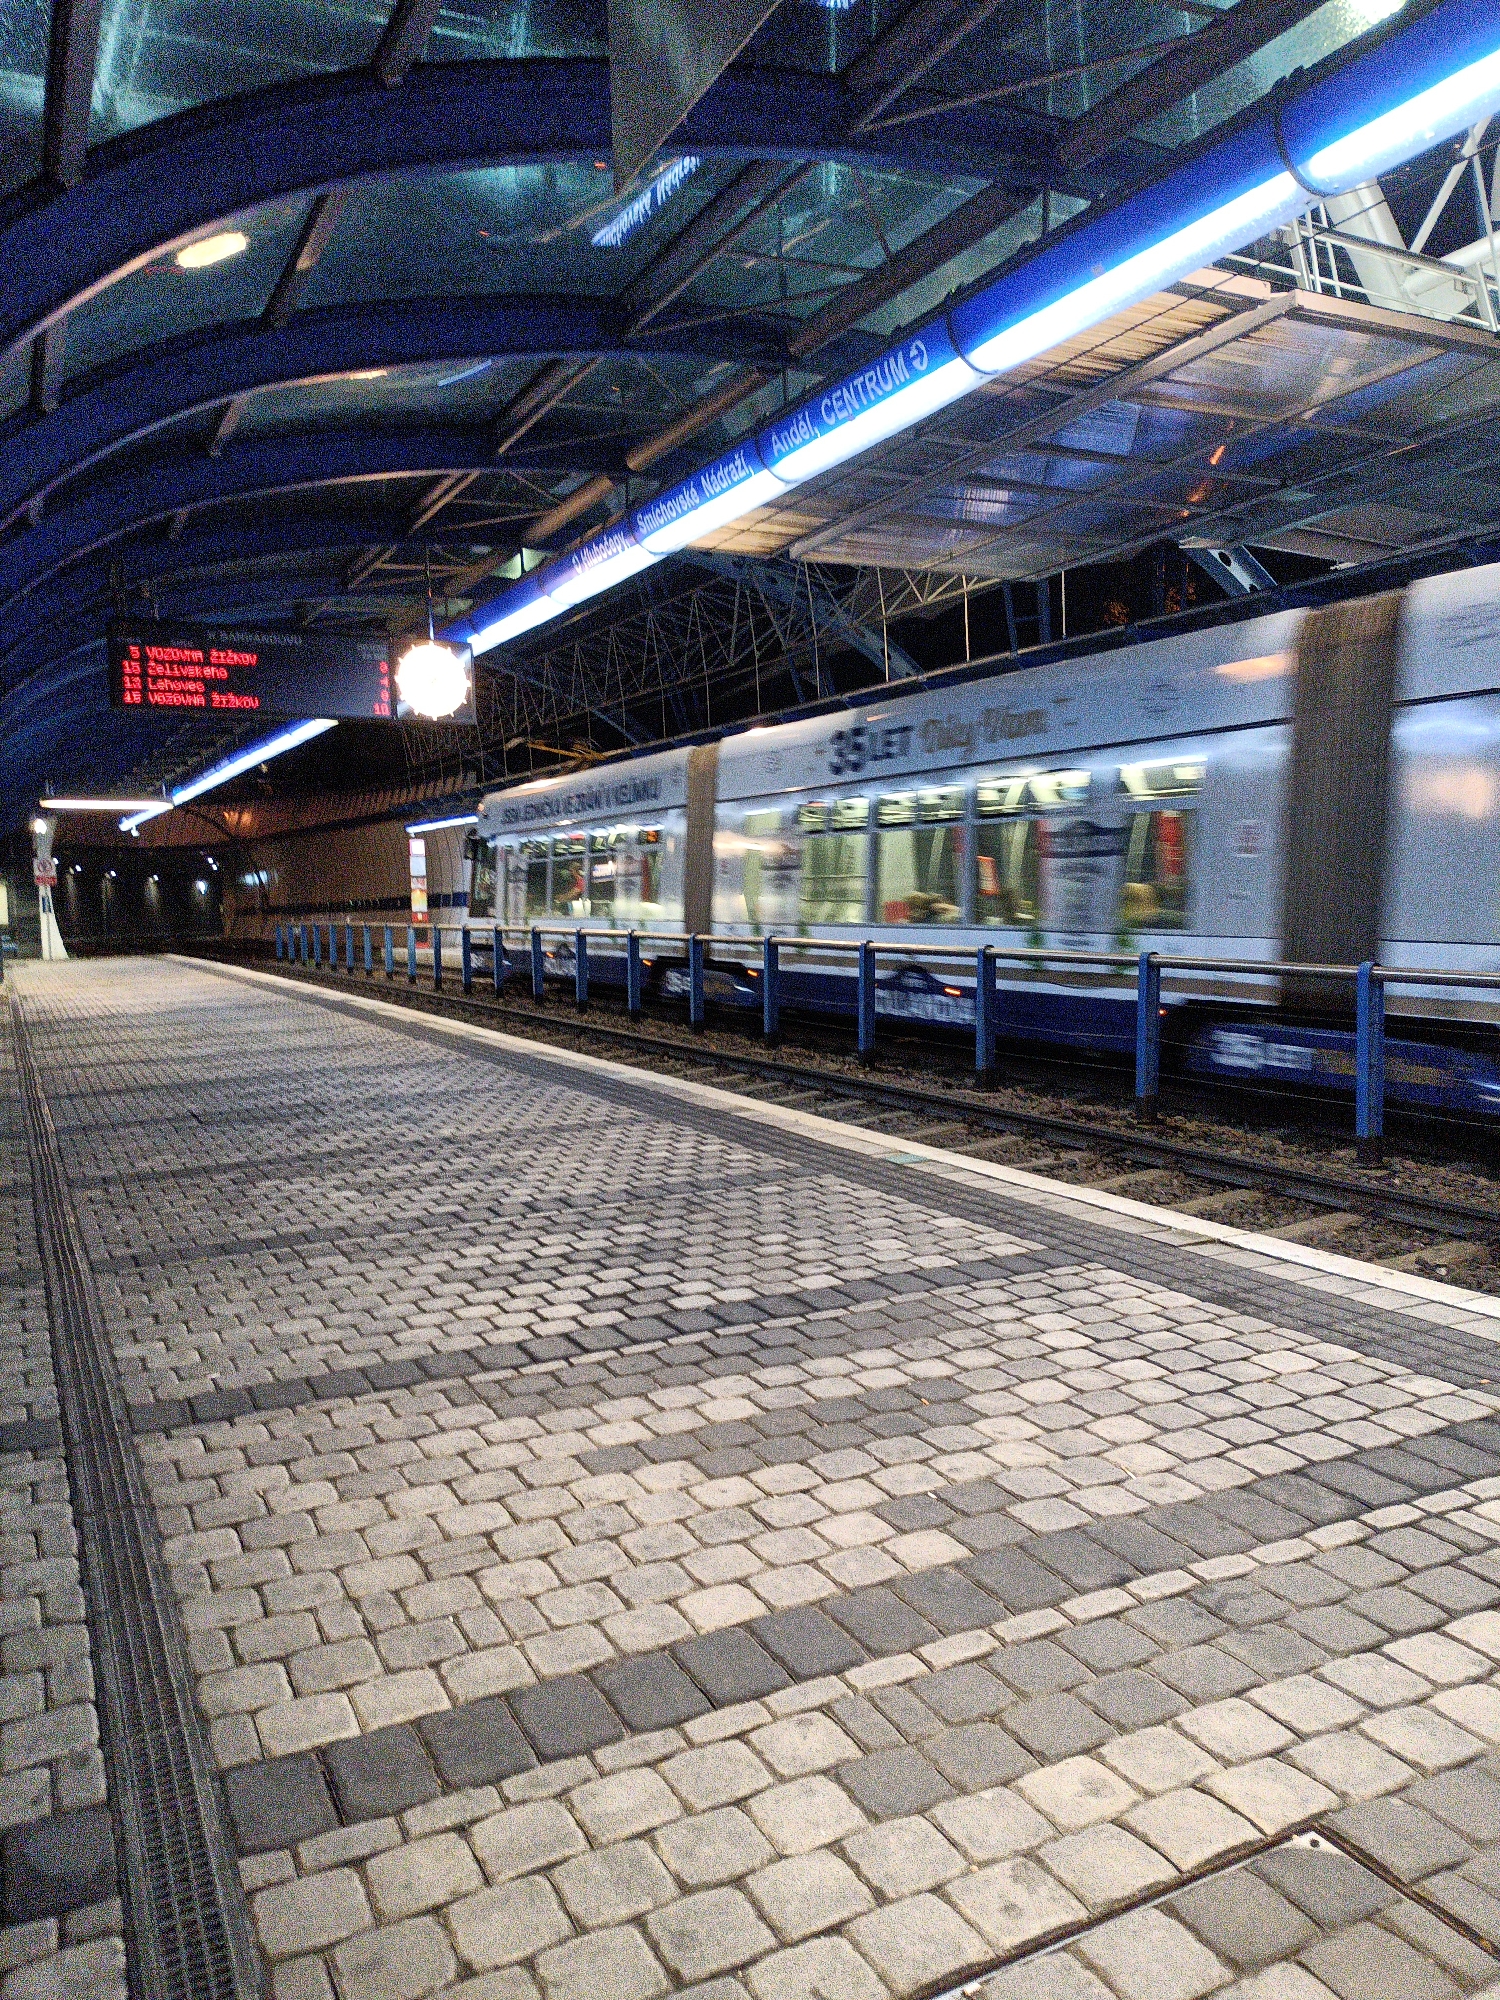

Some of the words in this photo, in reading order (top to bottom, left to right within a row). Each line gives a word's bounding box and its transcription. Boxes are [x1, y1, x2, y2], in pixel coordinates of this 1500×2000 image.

[637, 480, 699, 535] Smíchovské
[701, 449, 754, 499] Nádraží,
[771, 411, 821, 457] Anděl,
[821, 351, 910, 426] CENTRUM
[148, 691, 206, 706] VOZOVNA
